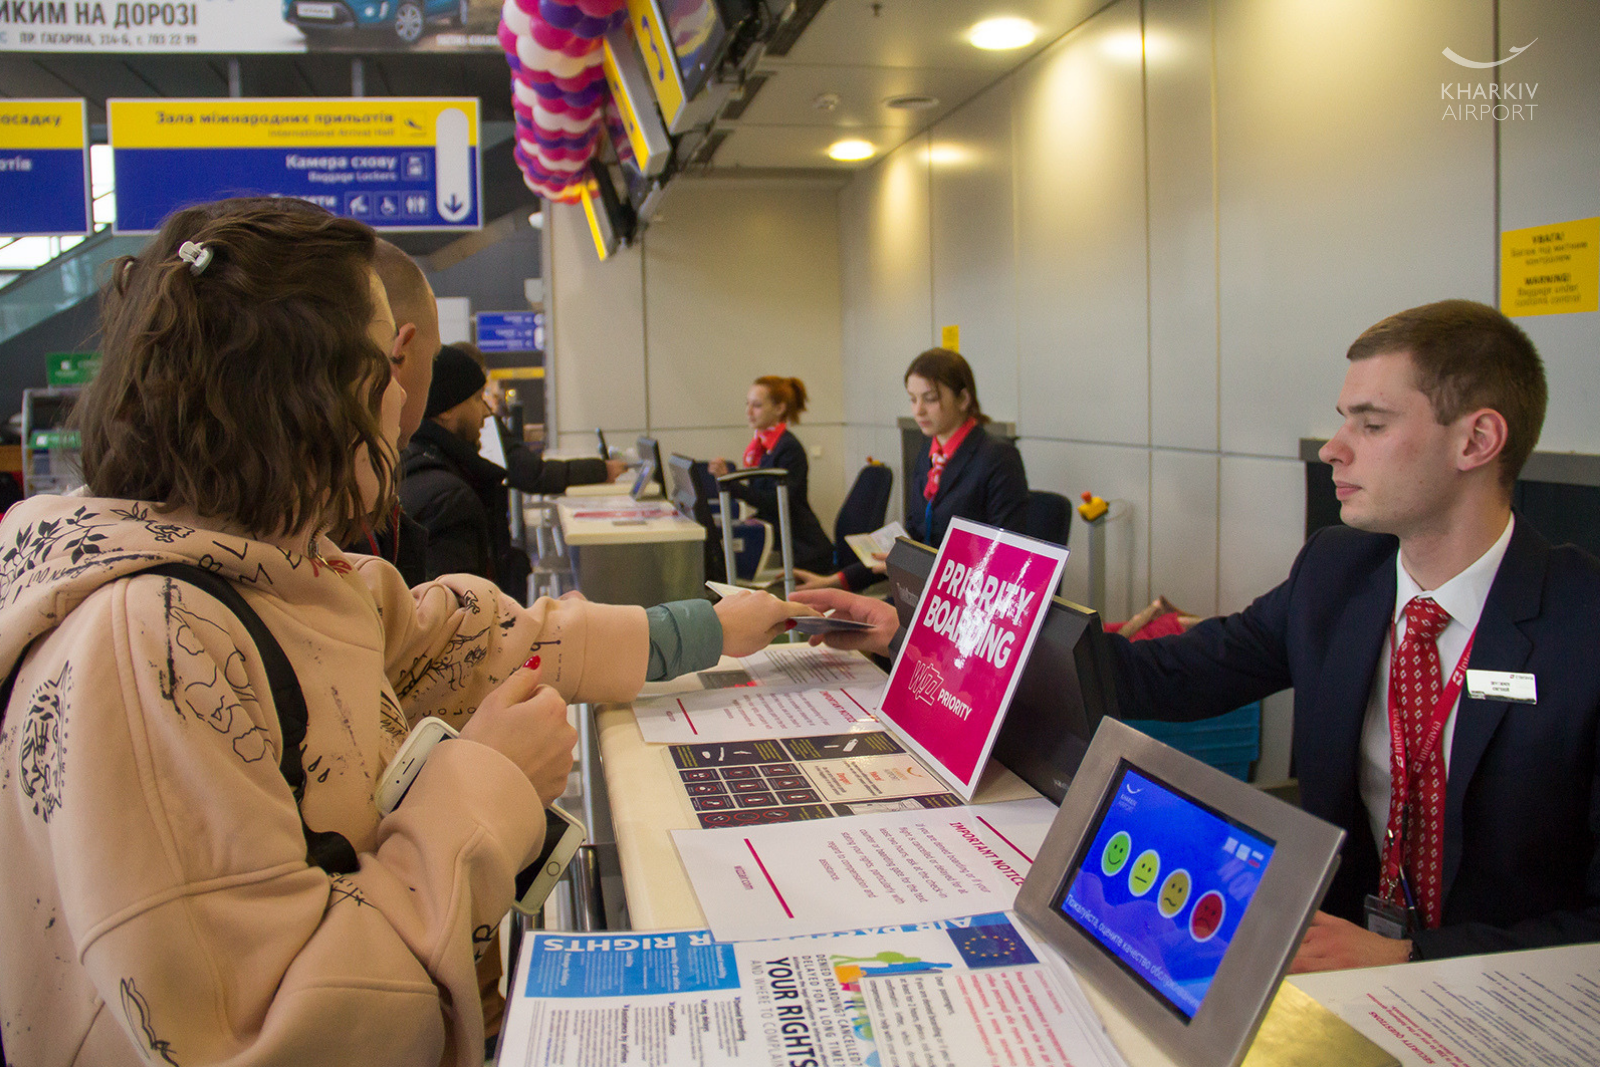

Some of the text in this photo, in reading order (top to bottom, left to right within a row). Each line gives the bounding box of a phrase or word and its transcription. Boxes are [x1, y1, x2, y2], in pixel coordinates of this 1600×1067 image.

[75, 3, 106, 25] НА
[114, 3, 197, 28] ДОРОЗІ
[169, 34, 181, 44] 22
[0, 114, 62, 126] осадку
[156, 112, 394, 128] Зала міжнародних прильотів
[0, 156, 32, 171] отів
[286, 154, 397, 171] Камера схову
[308, 172, 397, 184] Baggage Lockers
[937, 559, 1035, 627] PRIORITY
[937, 688, 973, 721] PRIORITY
[857, 829, 876, 843] counter
[874, 848, 896, 866] boarding
[890, 867, 906, 876] gate
[905, 884, 919, 892] the
[910, 840, 934, 858] cancelled
[933, 864, 956, 880] delayed
[948, 821, 1027, 886] IMPORTANT NOTICE
[840, 859, 869, 888] compensation
[863, 889, 877, 897] and
[932, 841, 953, 854] denied
[946, 855, 971, 872] boarding
[974, 883, 992, 892] your
[870, 868, 896, 892] particularly
[1063, 893, 1101, 929] Пожалуйста,
[1096, 922, 1124, 947] оцените
[1120, 941, 1153, 970] качество
[543, 937, 676, 952] RIGHTS
[752, 960, 764, 974] AND
[815, 954, 832, 975] DENIED
[754, 978, 770, 1004] WHERE
[801, 955, 820, 985] DELAYED
[811, 989, 825, 1002] FOR
[819, 1015, 836, 1037] LONG
[823, 978, 846, 1016] BOARDING?
[621, 1008, 629, 1033] Assistance
[667, 1006, 676, 1035] Cancellation
[760, 1008, 773, 1018] TO
[765, 957, 818, 1067] YOUR RIGHTS
[737, 1018, 746, 1041] boarding
[1367, 1008, 1435, 1066] SECURITY QUESTIONS
[620, 1043, 629, 1063] airlines
